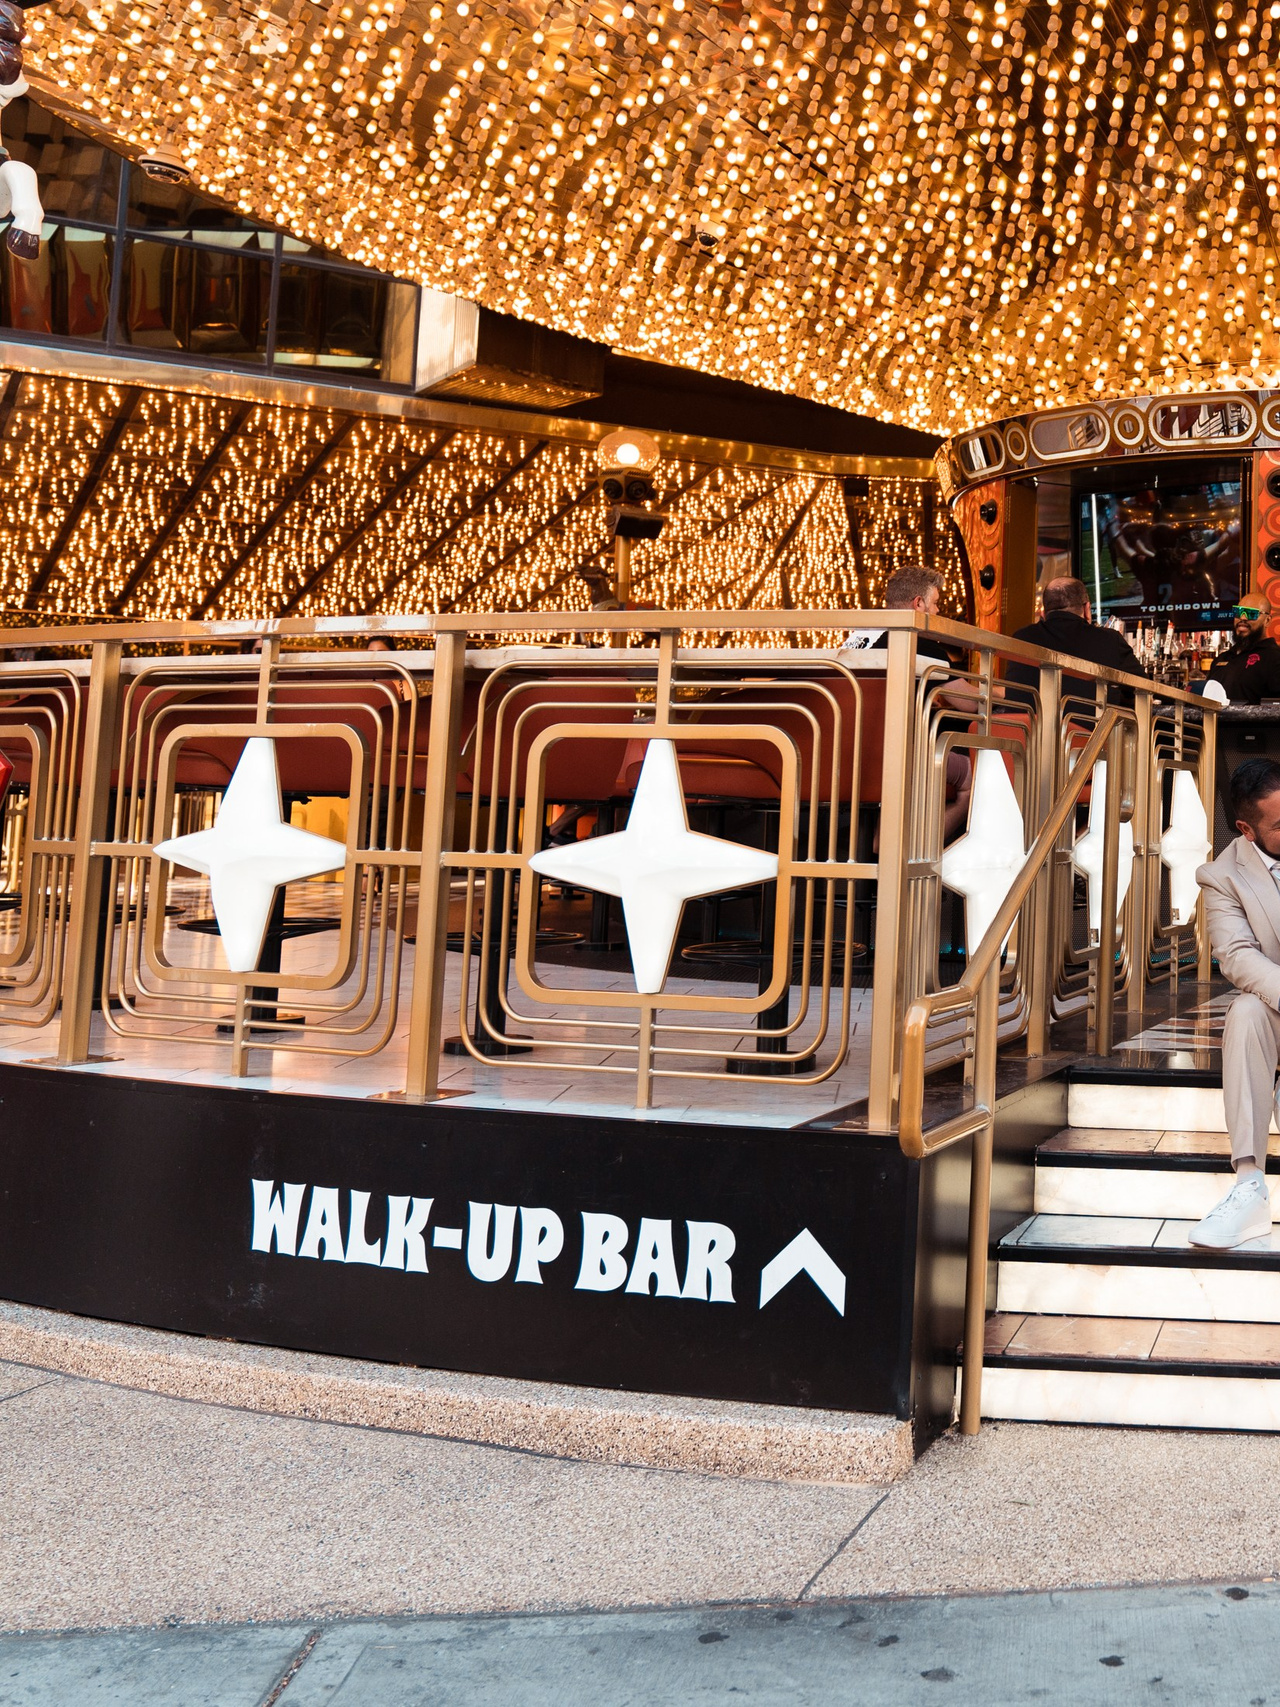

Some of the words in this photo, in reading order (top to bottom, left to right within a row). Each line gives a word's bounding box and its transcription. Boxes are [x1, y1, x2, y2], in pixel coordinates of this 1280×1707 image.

[1141, 602, 1220, 613] TOUCHDOWN
[252, 1178, 565, 1285] WALK-UP
[574, 1211, 737, 1304] BAR
